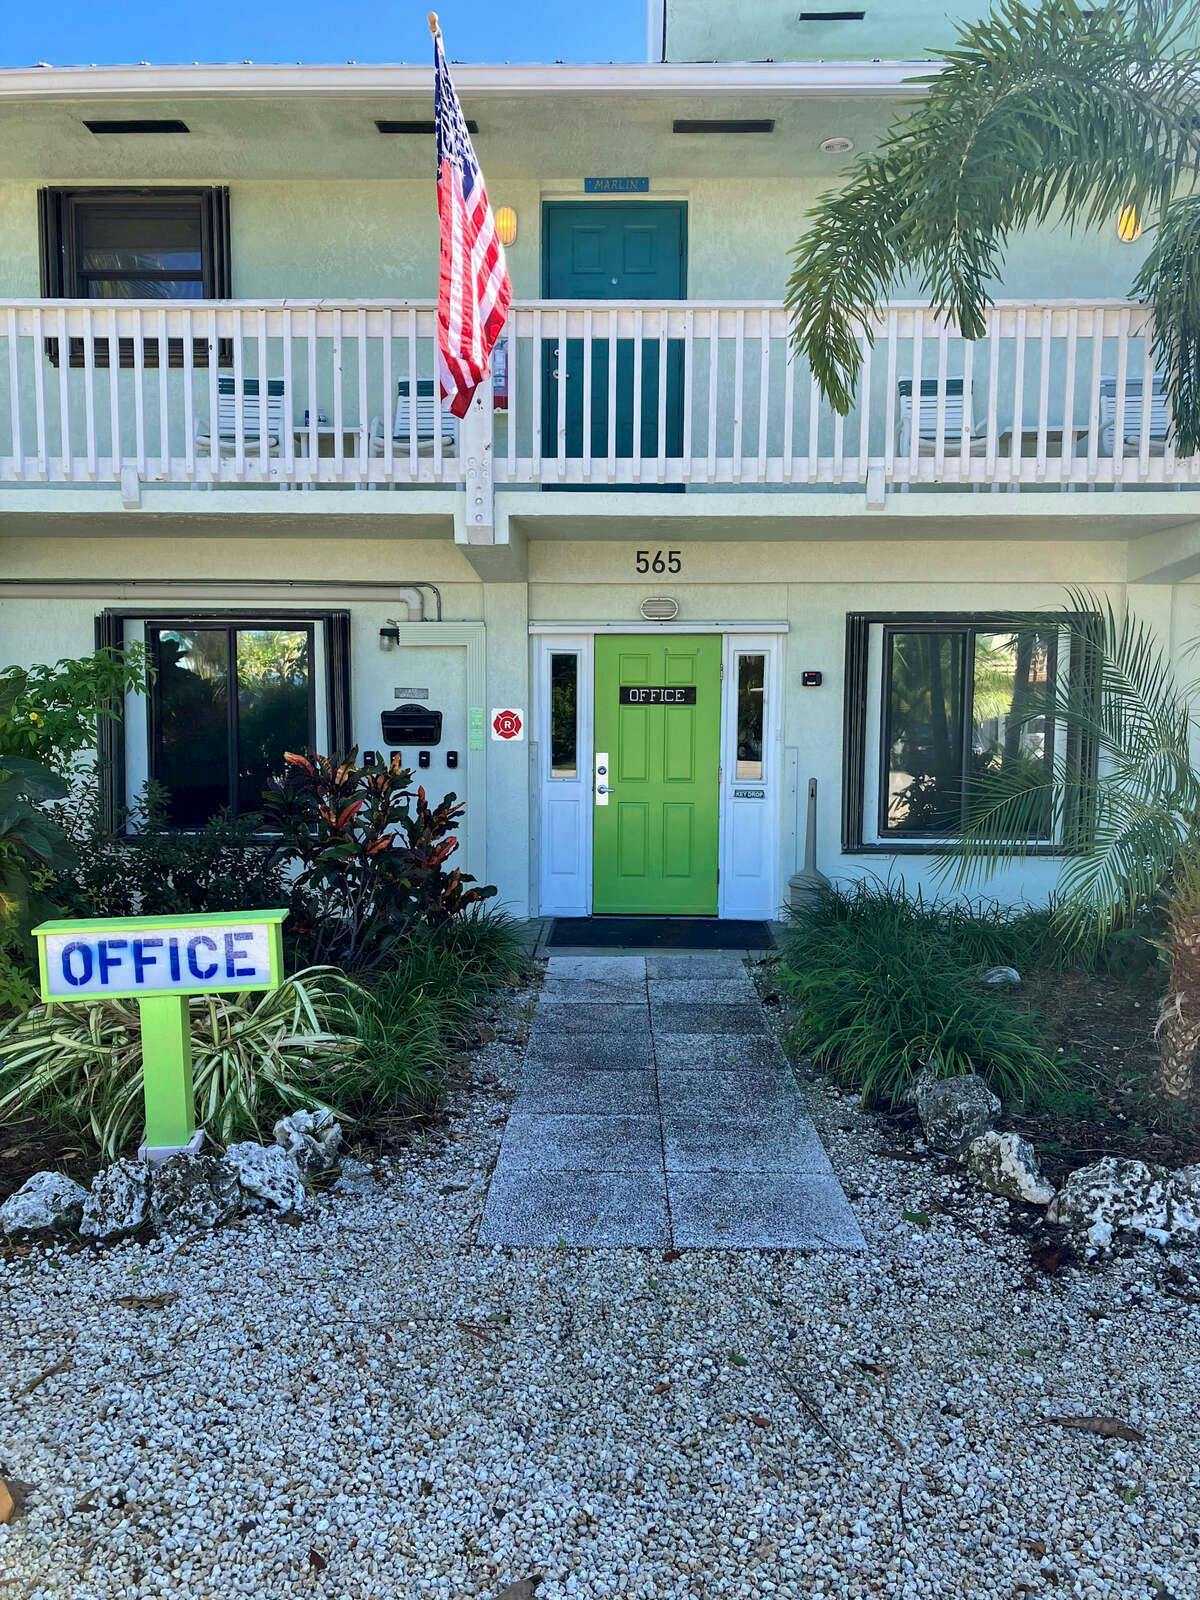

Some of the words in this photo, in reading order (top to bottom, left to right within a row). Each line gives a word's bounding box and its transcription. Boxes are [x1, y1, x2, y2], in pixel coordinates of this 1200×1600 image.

[594, 179, 639, 190] MARLIN
[636, 550, 681, 573] 565
[629, 689, 685, 702] OFFICE
[504, 720, 511, 729] R
[61, 931, 256, 986] OFFICE
